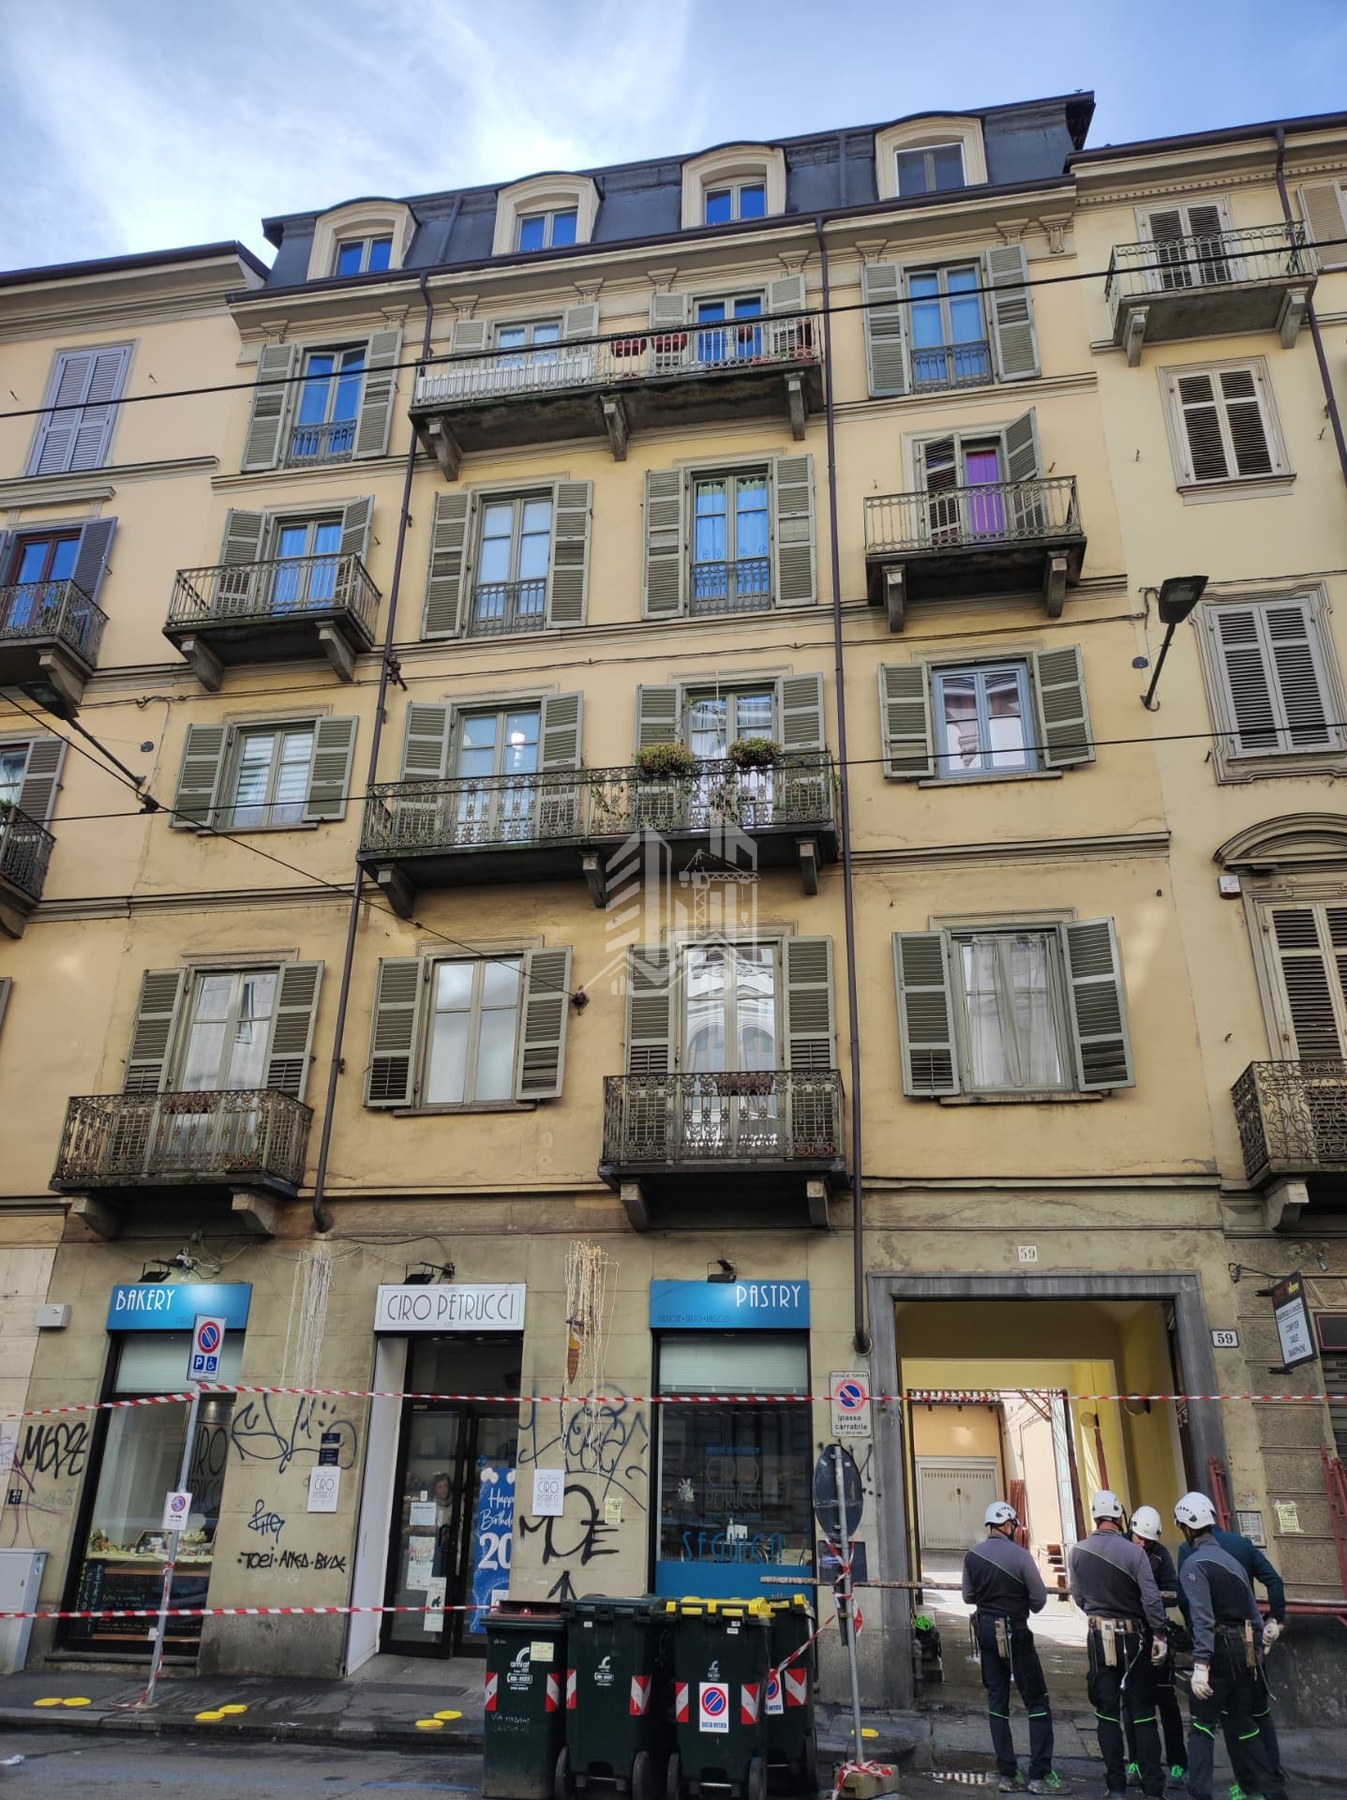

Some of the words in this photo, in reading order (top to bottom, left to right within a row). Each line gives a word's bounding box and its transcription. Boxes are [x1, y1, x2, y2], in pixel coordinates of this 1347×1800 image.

[1019, 1247, 1036, 1260] 59
[115, 1289, 176, 1311] BAKERY
[736, 1285, 801, 1308] PASTRY
[387, 1294, 432, 1321] CIRO
[437, 1293, 514, 1321] PETRUCCI
[1216, 1333, 1234, 1345] 59
[834, 1423, 868, 1431] carrabile
